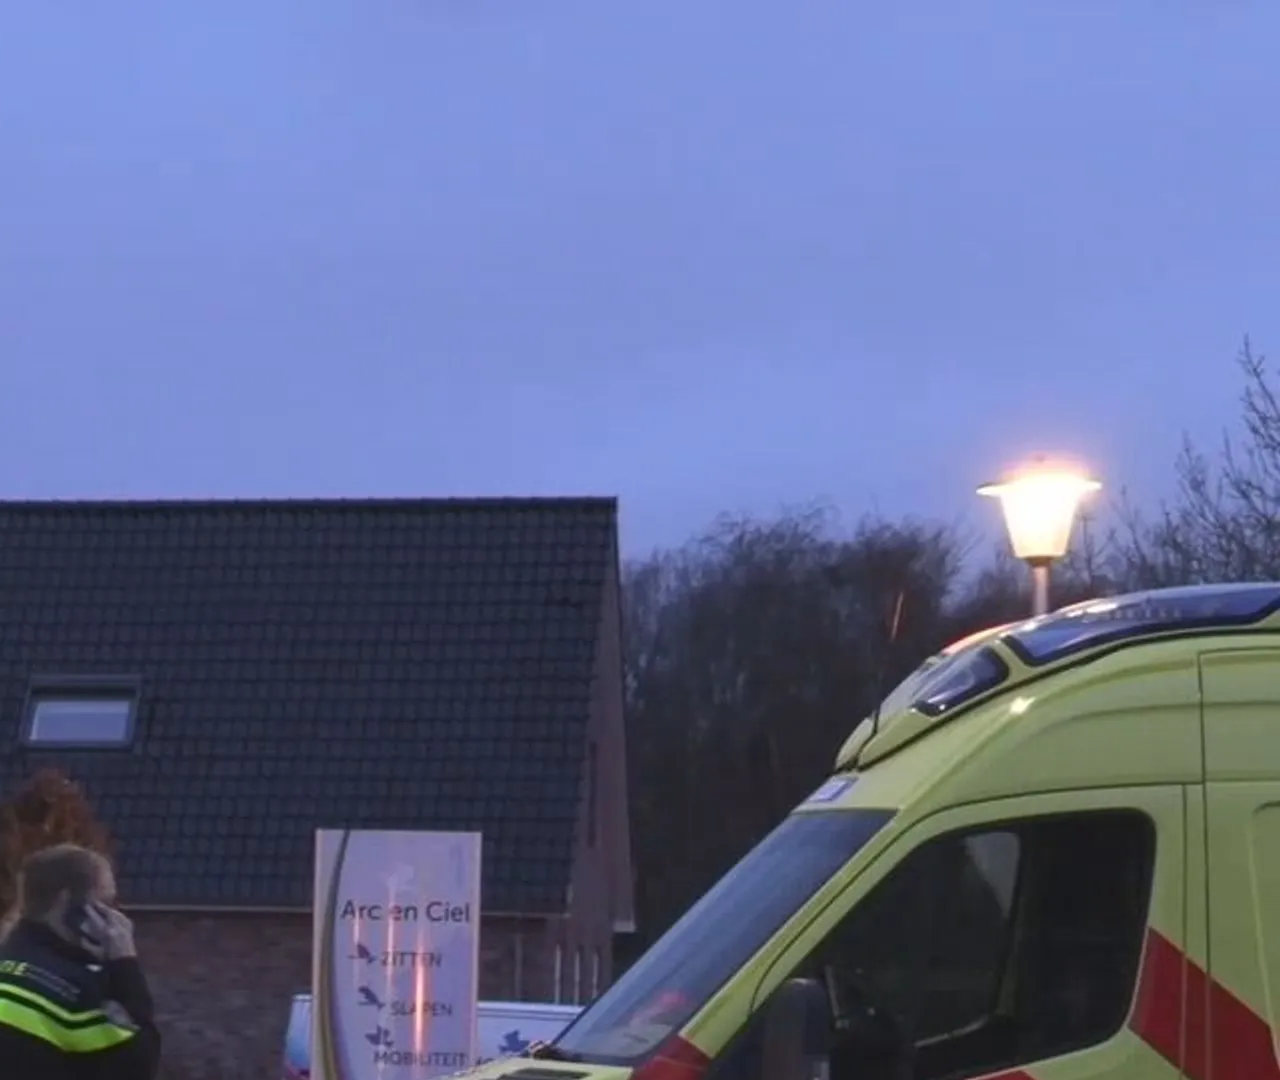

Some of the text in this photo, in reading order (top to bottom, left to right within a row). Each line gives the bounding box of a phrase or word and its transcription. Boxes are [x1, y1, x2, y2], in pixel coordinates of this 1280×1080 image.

[340, 900, 470, 922] Arc en Ciel
